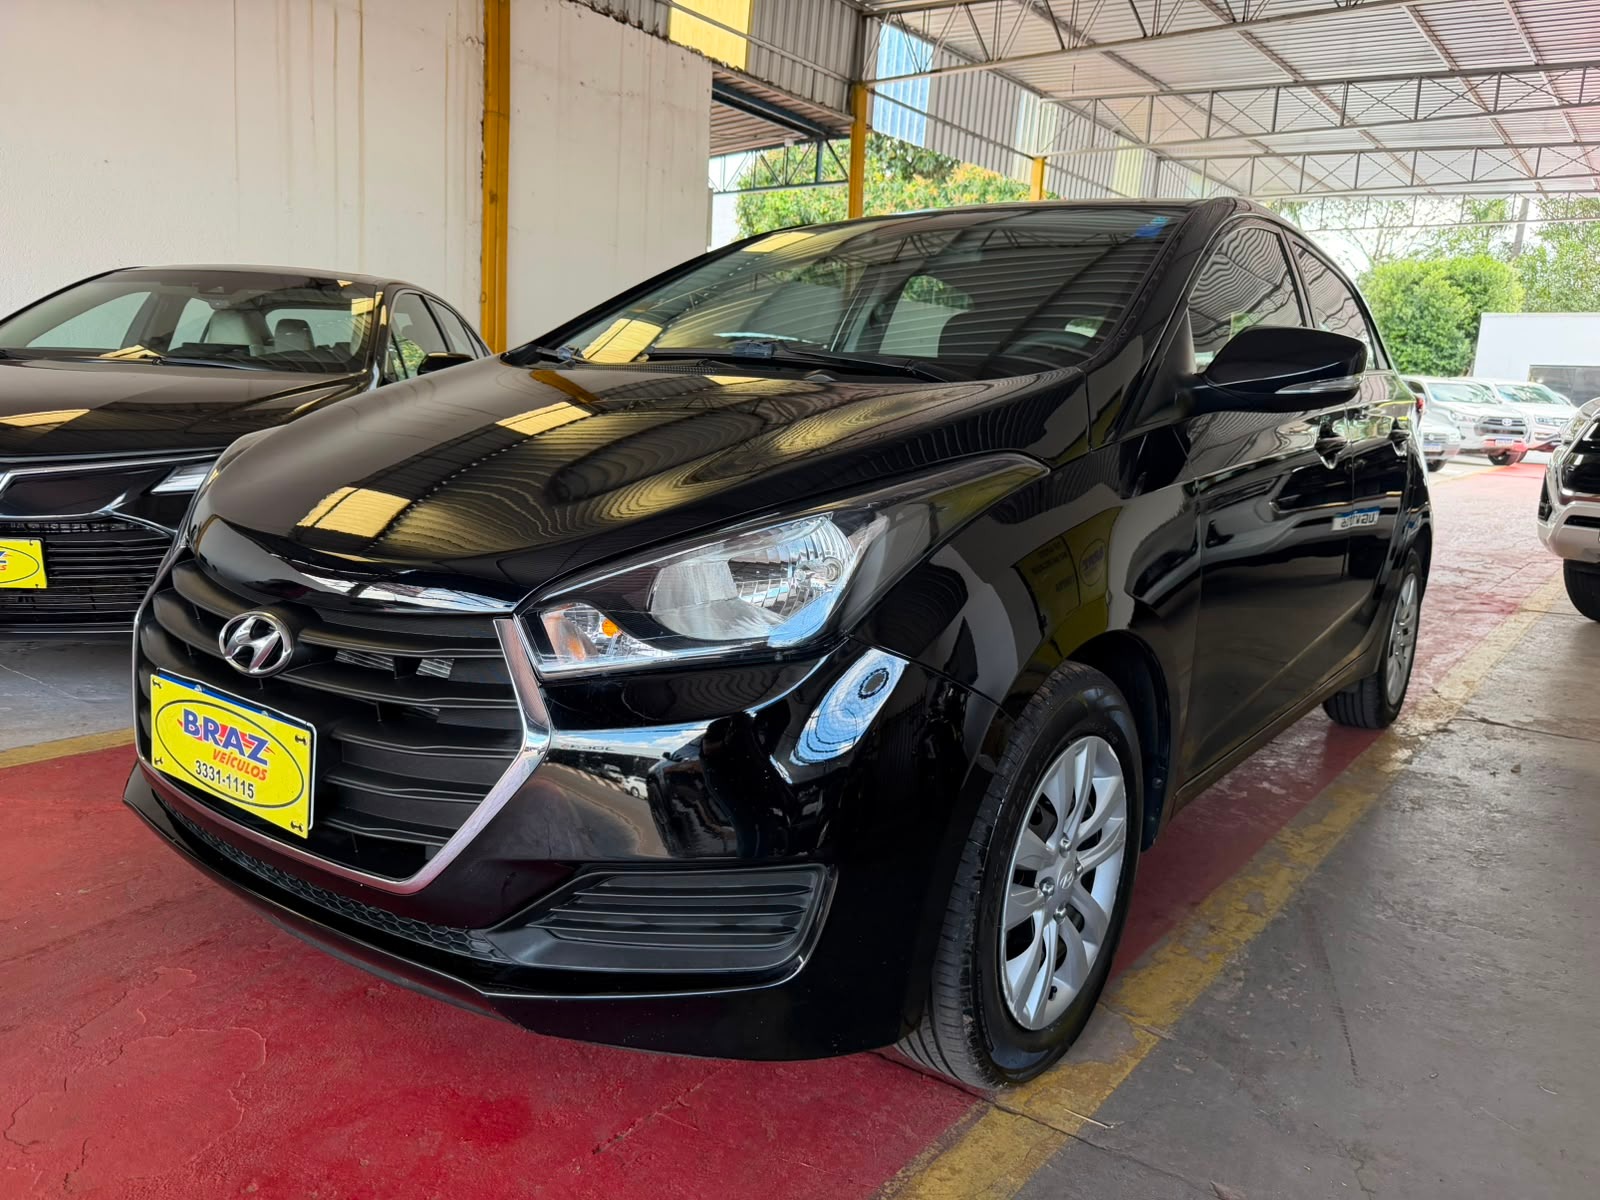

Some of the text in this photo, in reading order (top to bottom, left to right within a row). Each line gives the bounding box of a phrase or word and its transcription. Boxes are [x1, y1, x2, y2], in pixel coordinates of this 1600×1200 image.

[183, 708, 269, 766] BRAZ
[195, 760, 255, 799] 3331-1115
[212, 749, 268, 782] VEÍCULOS
